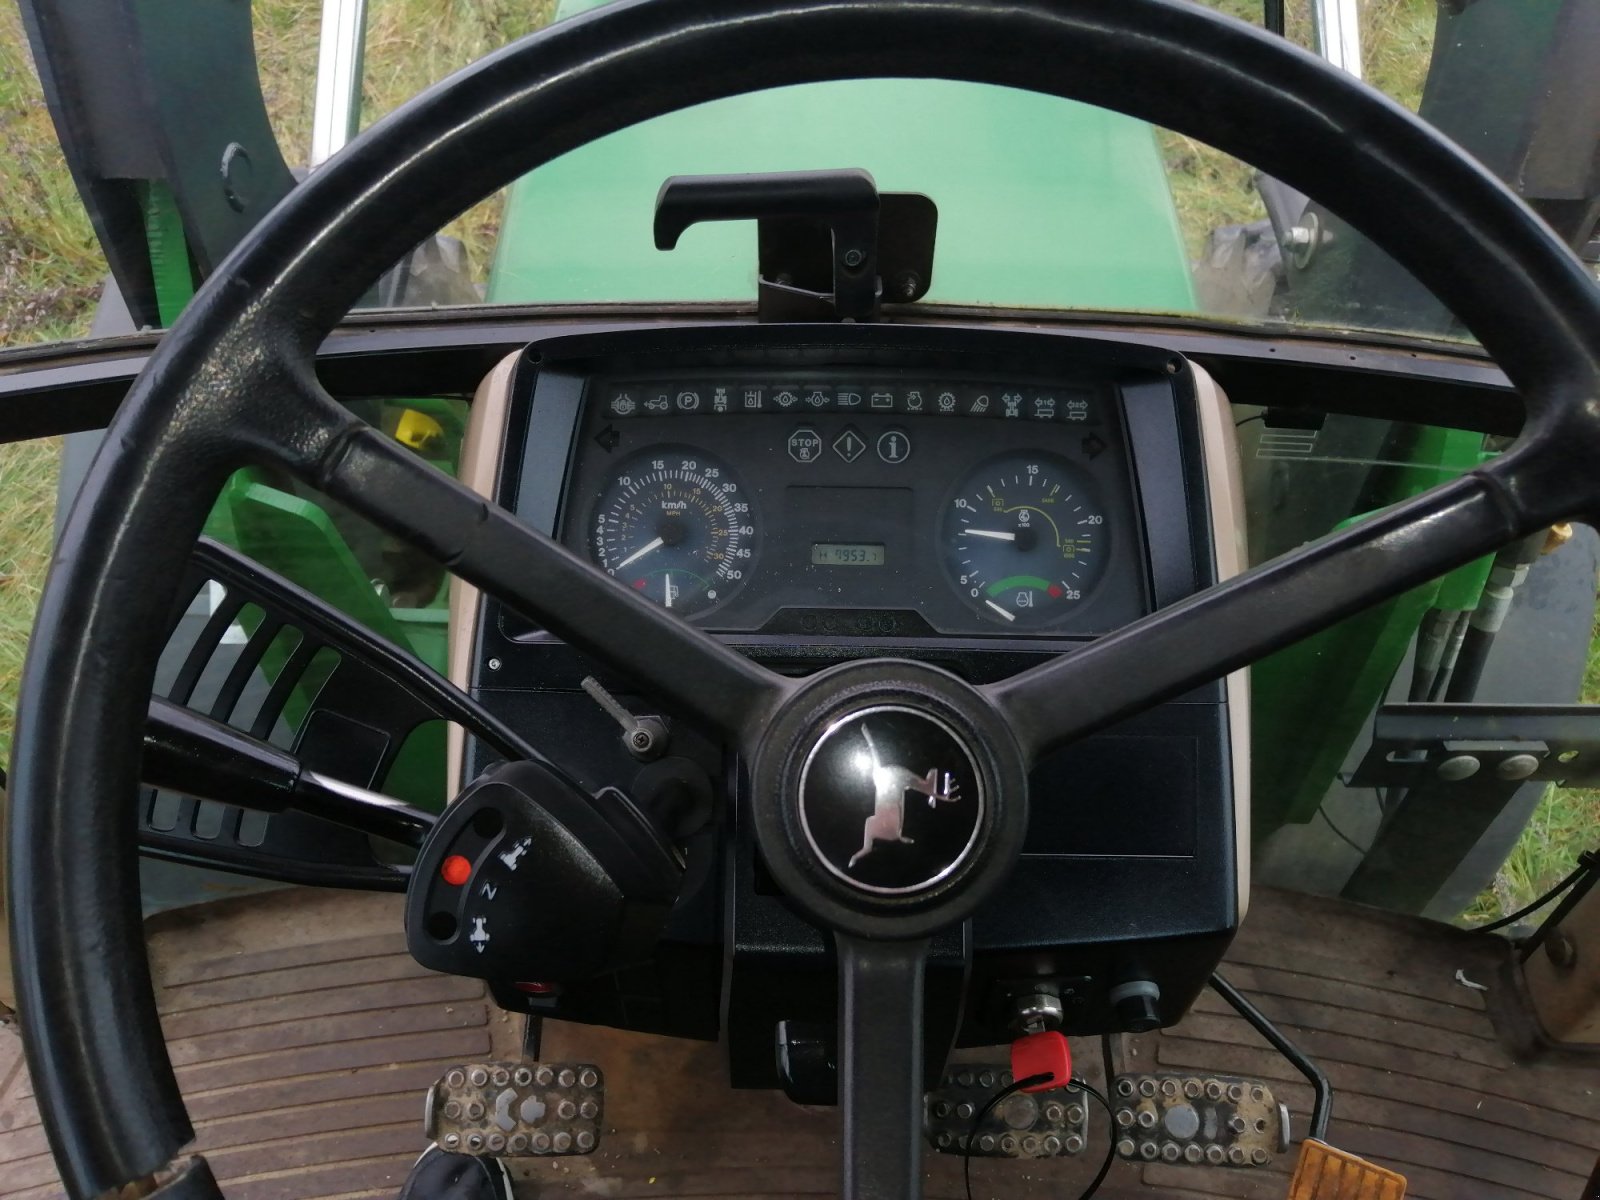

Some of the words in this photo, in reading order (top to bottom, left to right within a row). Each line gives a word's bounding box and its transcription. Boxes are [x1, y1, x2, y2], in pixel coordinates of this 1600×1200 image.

[791, 438, 819, 447] STOP
[651, 460, 665, 470] 15
[681, 460, 697, 470] 20
[1026, 465, 1039, 475] 15
[704, 468, 719, 478] 25
[617, 476, 631, 486] 10
[692, 487, 701, 495] 15
[722, 483, 737, 493] 30
[661, 500, 687, 510] km/h
[734, 503, 749, 513] 35
[954, 499, 967, 508] 10
[598, 514, 606, 524] 5
[1088, 515, 1103, 525] 20
[596, 525, 604, 534] 4
[718, 529, 729, 537] 25
[739, 526, 754, 535] 40
[596, 536, 604, 546] 3
[599, 547, 606, 557] 2
[713, 552, 725, 560] 30
[736, 549, 751, 559] 45
[602, 559, 608, 568] 1
[726, 570, 742, 580] 50
[960, 575, 968, 585] 5
[970, 588, 980, 598] 0
[1066, 589, 1081, 600] 25
